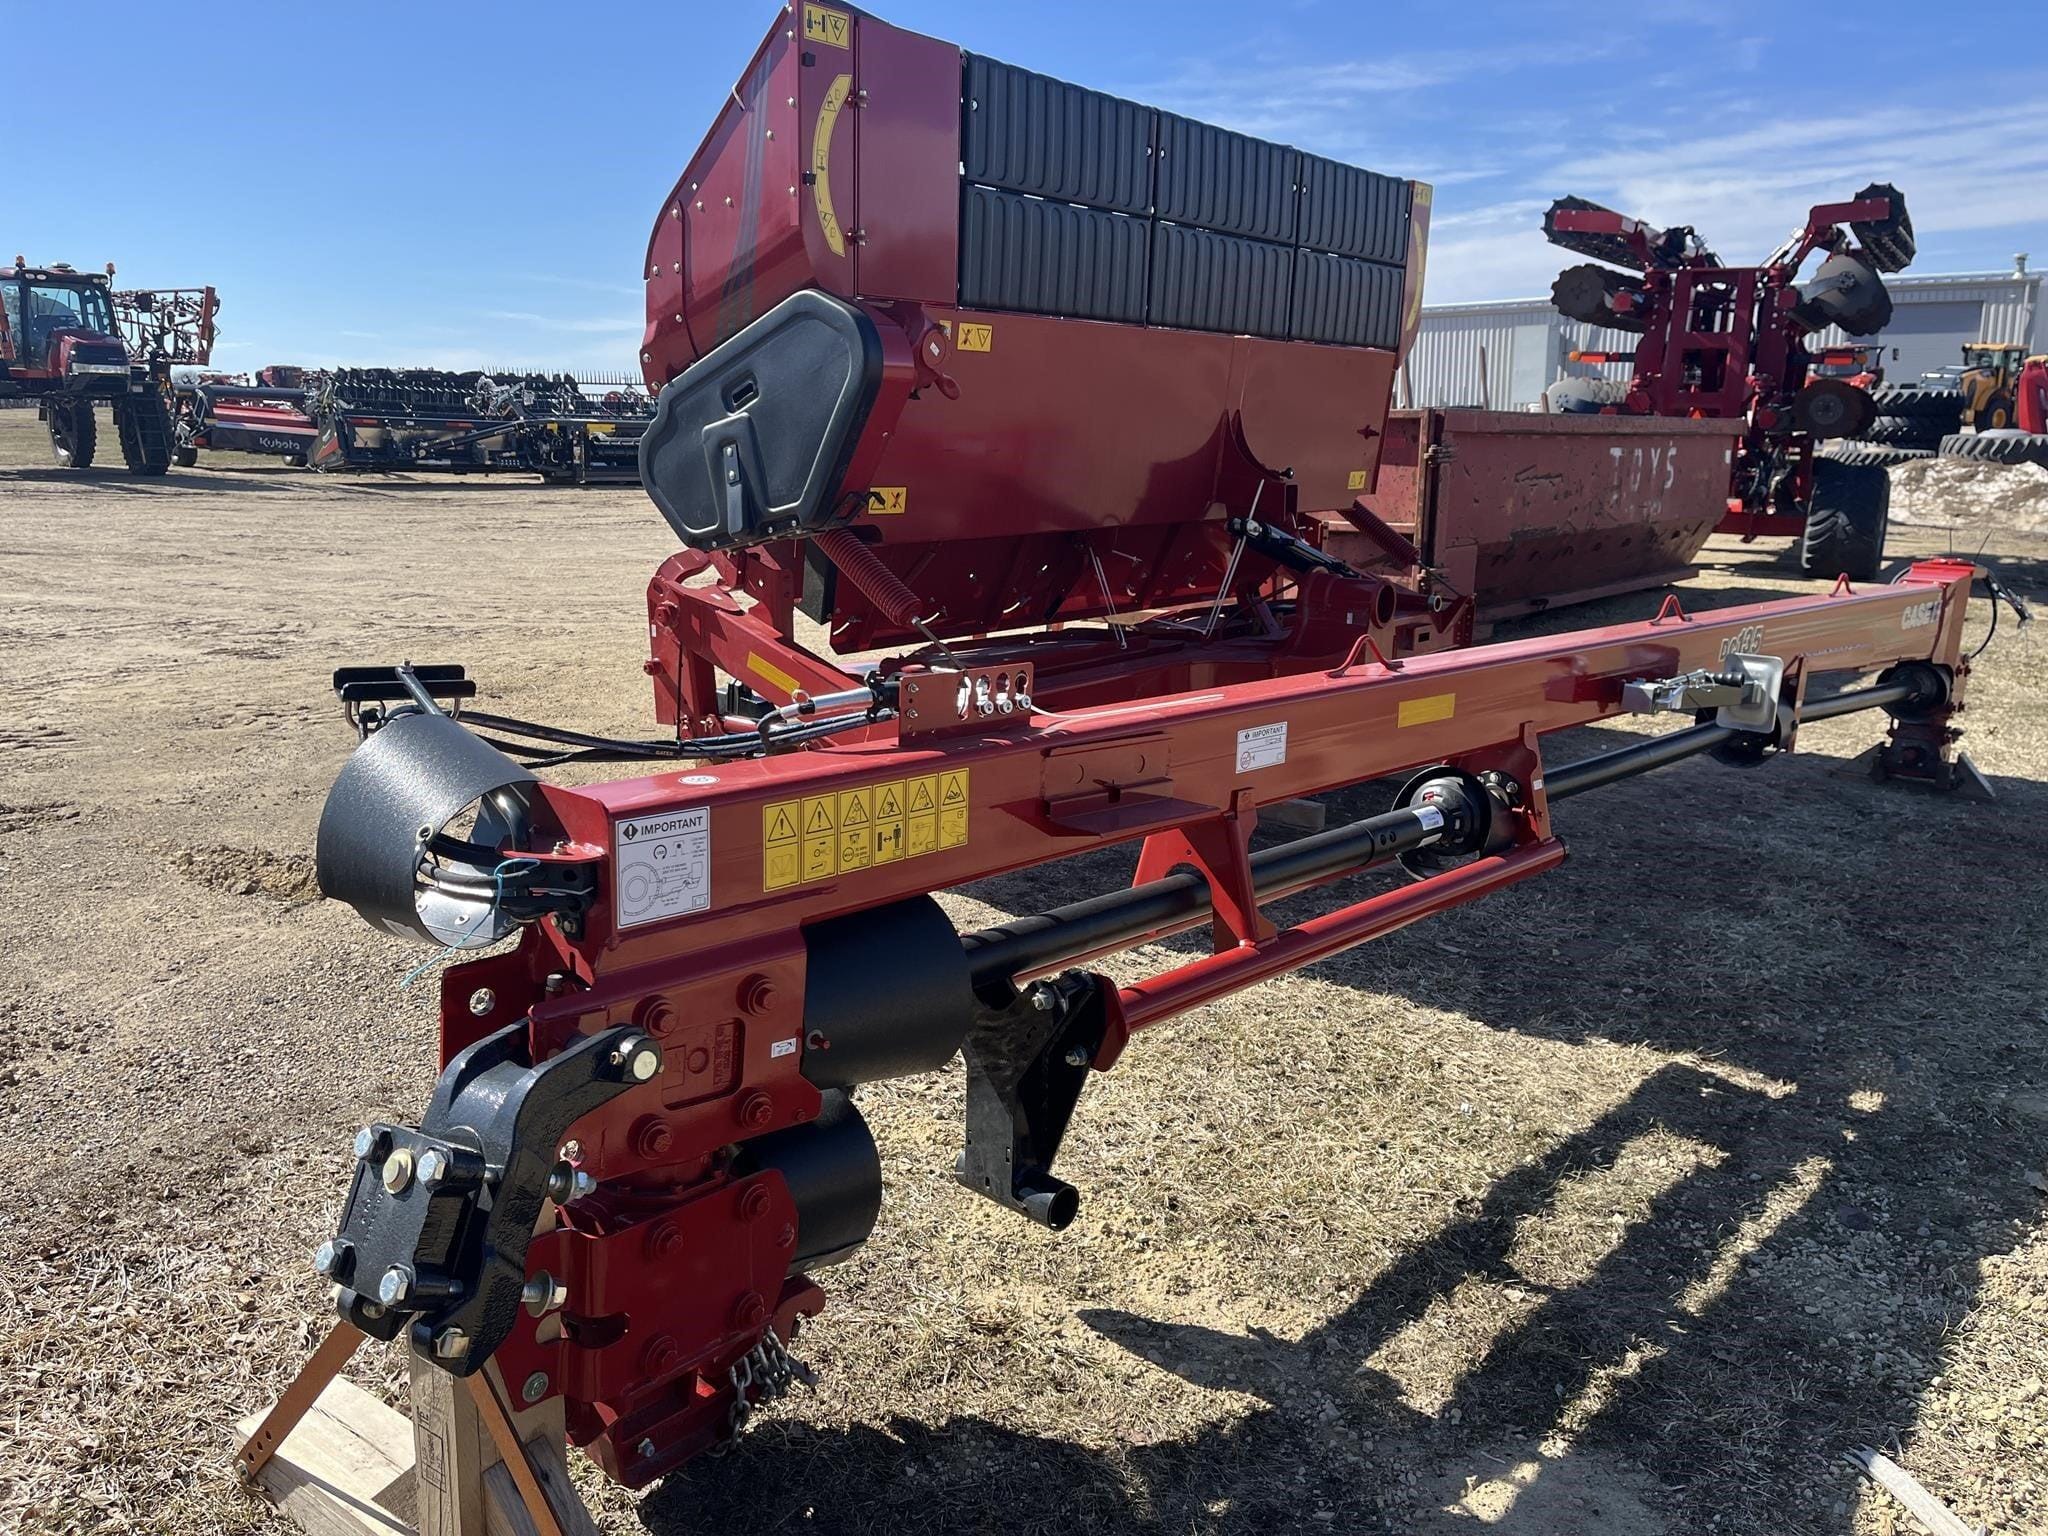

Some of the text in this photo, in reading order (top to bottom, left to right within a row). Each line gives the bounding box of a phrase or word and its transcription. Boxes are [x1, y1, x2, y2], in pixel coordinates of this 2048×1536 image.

[259, 436, 301, 450] Kubota
[1609, 446, 1678, 492] TOYS
[1252, 725, 1284, 739] IMPORTANT
[640, 816, 703, 836] IMPORTANT
